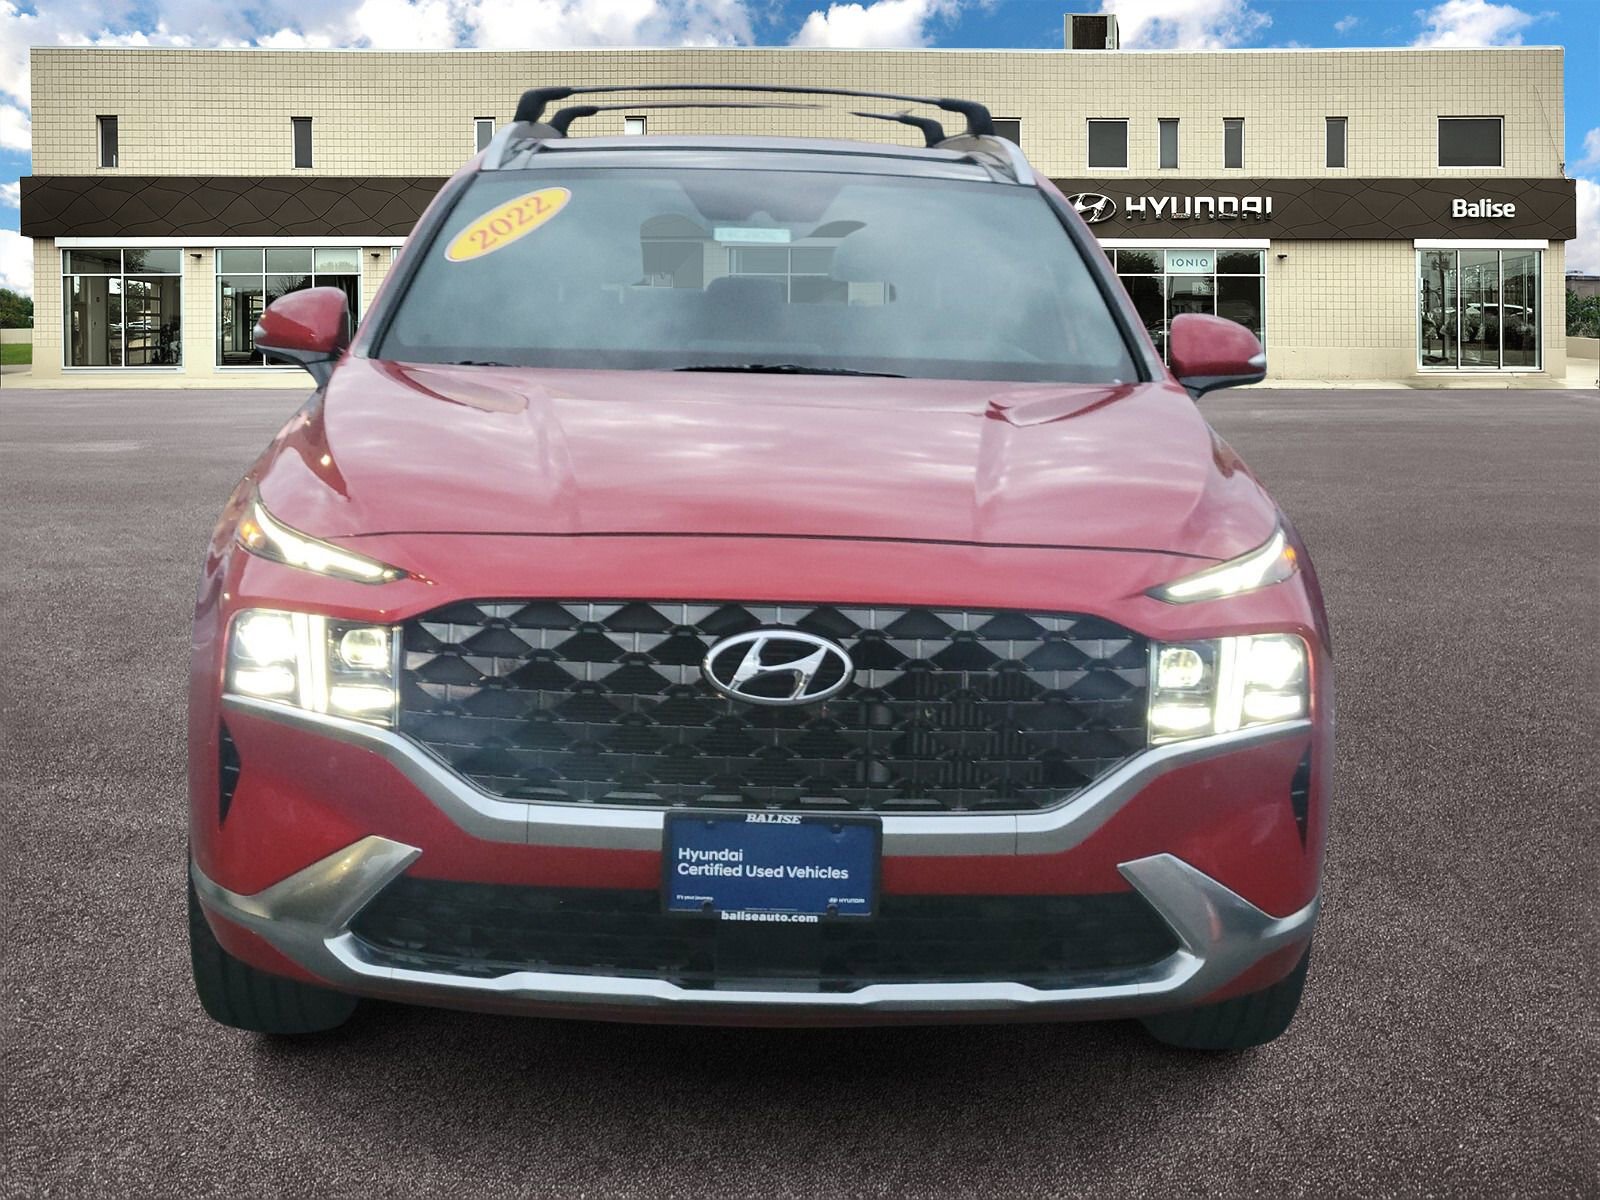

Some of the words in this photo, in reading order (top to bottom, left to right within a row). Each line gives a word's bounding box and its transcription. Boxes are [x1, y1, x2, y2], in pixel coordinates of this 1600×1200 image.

[1126, 196, 1272, 219] HYUNDAI
[1452, 198, 1516, 218] Balise
[469, 196, 552, 250] 2022
[1171, 258, 1209, 267] IONIQ
[745, 813, 802, 825] BALISE
[678, 848, 743, 863] Hyundai
[677, 863, 743, 877] Certified
[746, 865, 784, 878] Used
[787, 866, 849, 880] Vehicles
[721, 910, 818, 923] baliseauto.com
